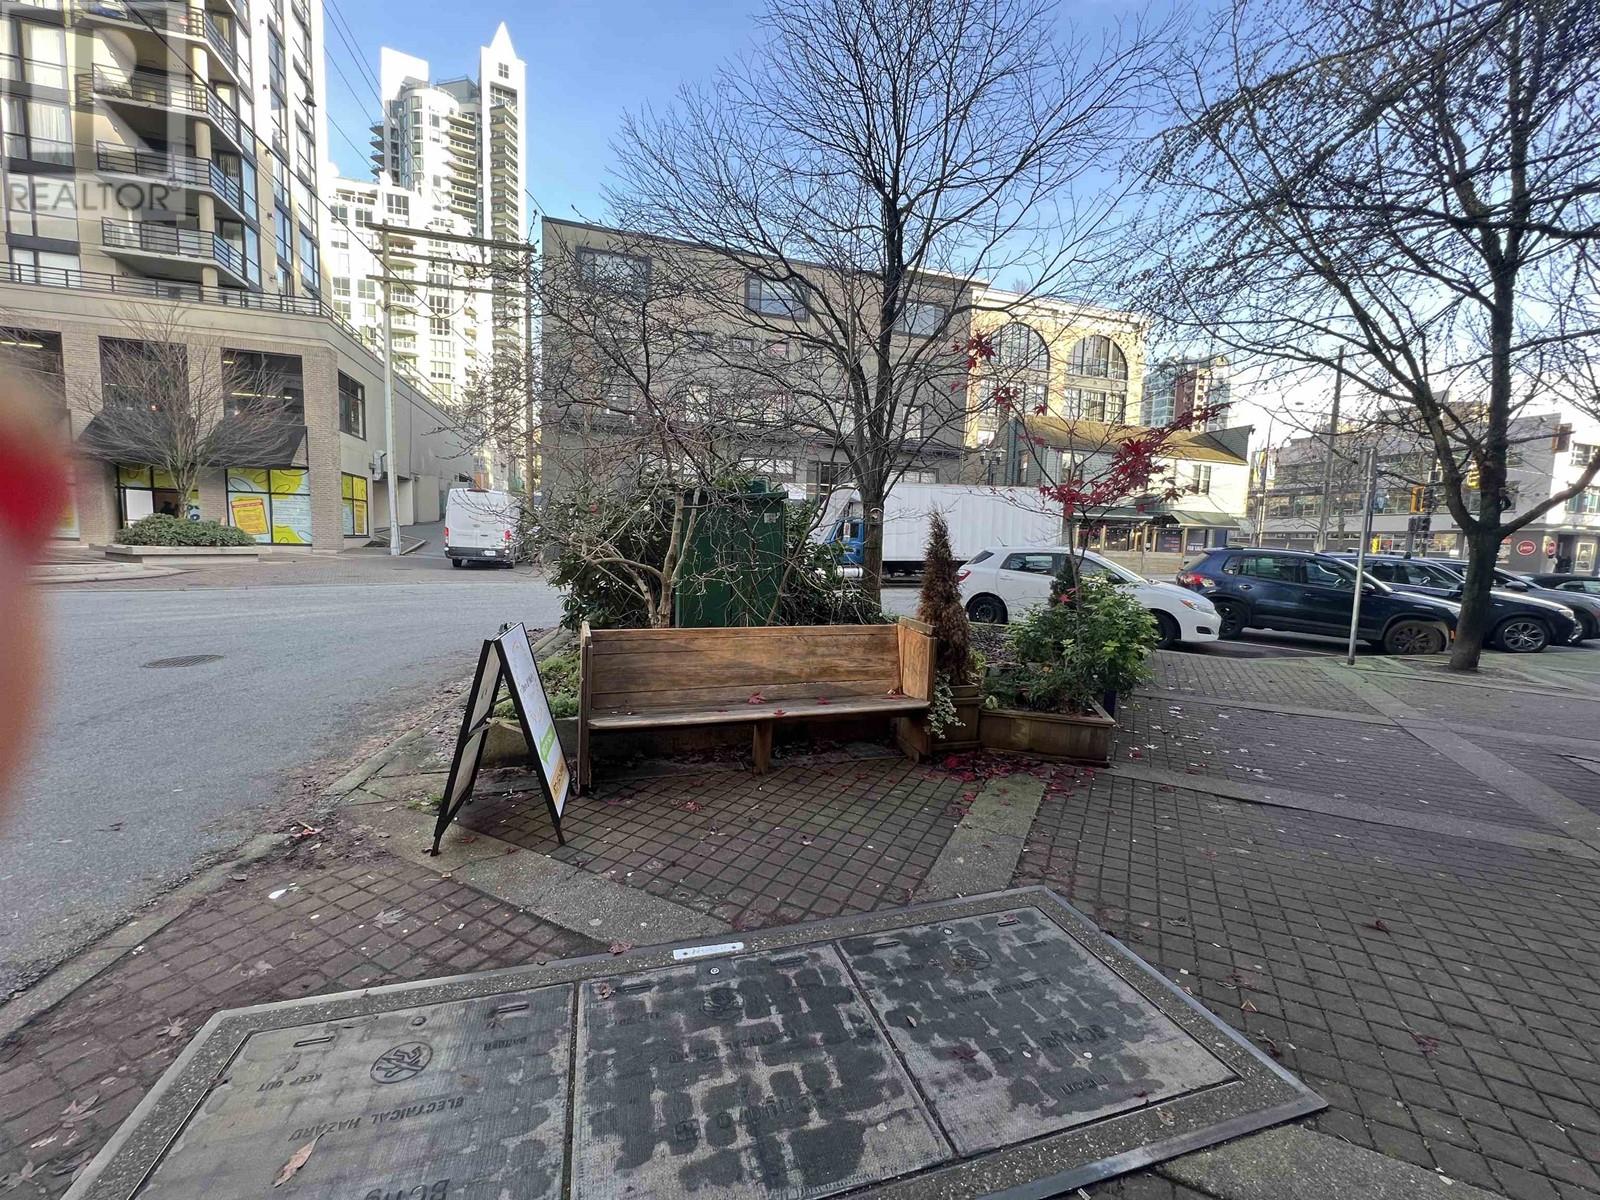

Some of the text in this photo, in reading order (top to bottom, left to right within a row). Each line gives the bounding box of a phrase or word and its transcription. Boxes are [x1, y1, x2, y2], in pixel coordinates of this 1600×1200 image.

[257, 1072, 323, 1093] KEEP OUT
[288, 1096, 464, 1142] ELECTRICAL HAZARD
